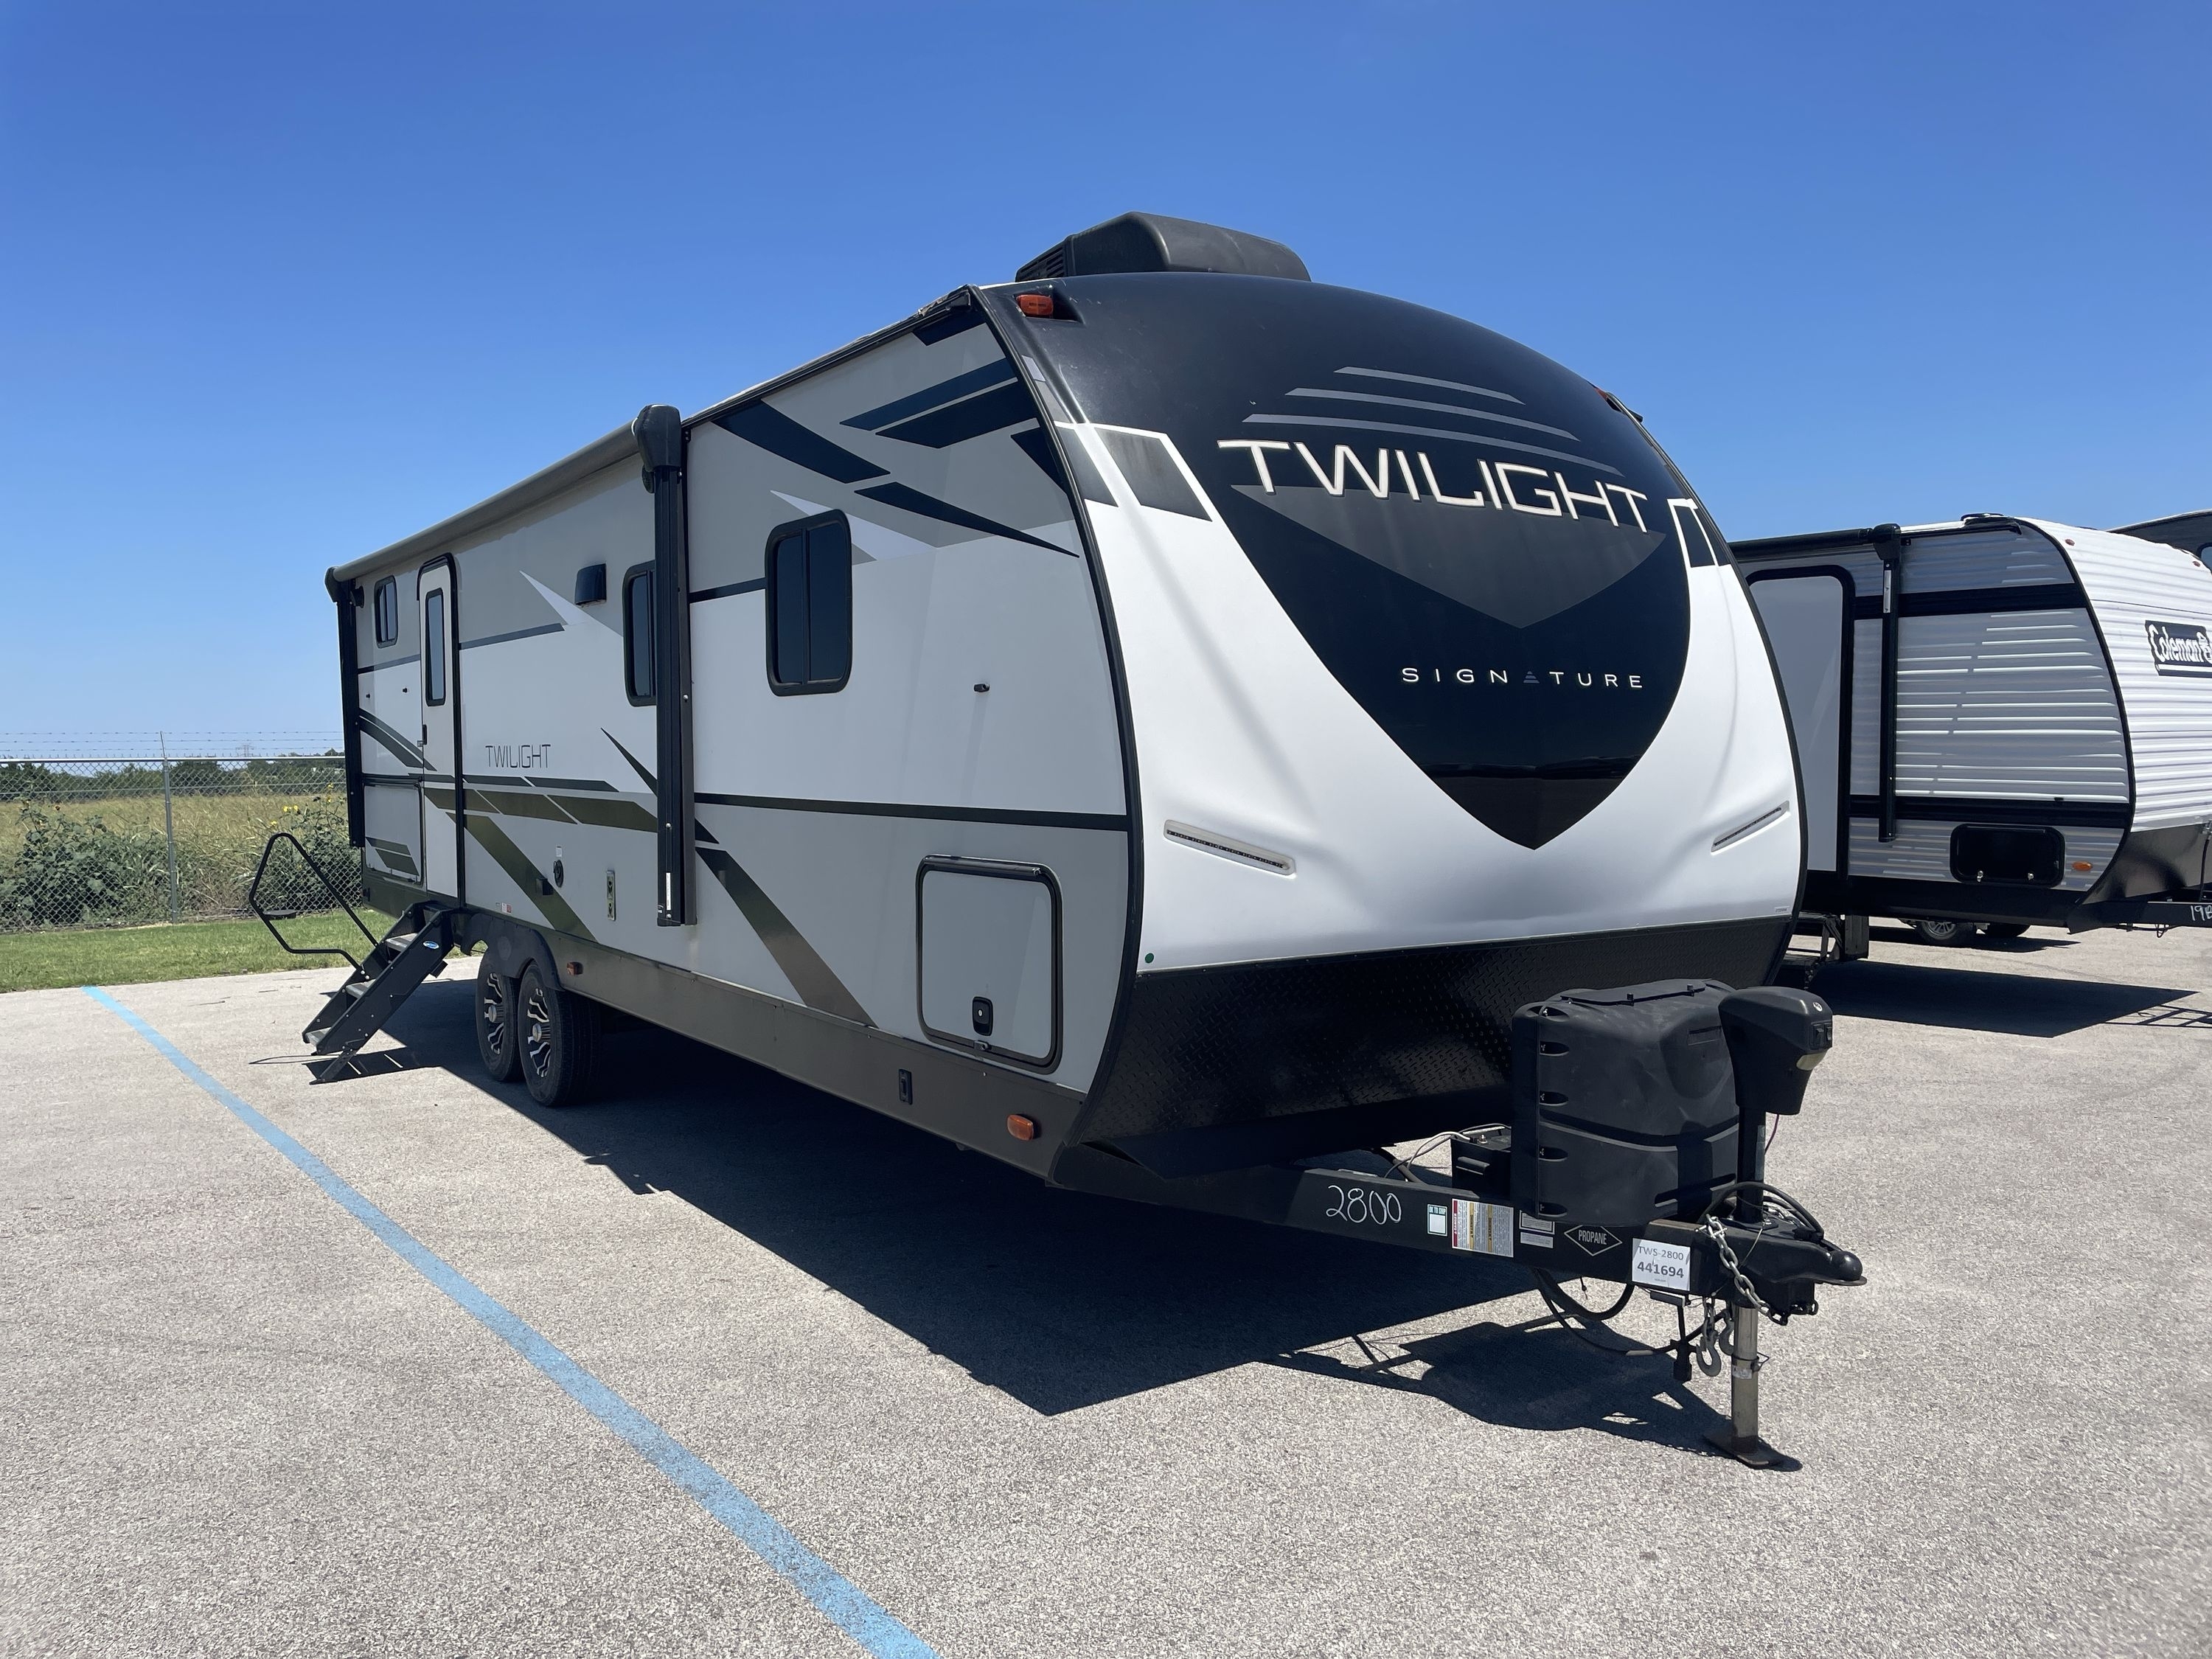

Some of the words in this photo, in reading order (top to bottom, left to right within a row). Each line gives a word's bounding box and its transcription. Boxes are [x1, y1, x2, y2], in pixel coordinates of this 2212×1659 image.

[1217, 439, 1648, 533] TWILIGHT
[2148, 624, 2205, 663] Coleman
[485, 744, 551, 768] TWILIGHT
[1326, 1185, 1402, 1225] 2800
[1579, 1229, 1607, 1245] PROPANE
[1637, 1262, 1684, 1278] 441694
